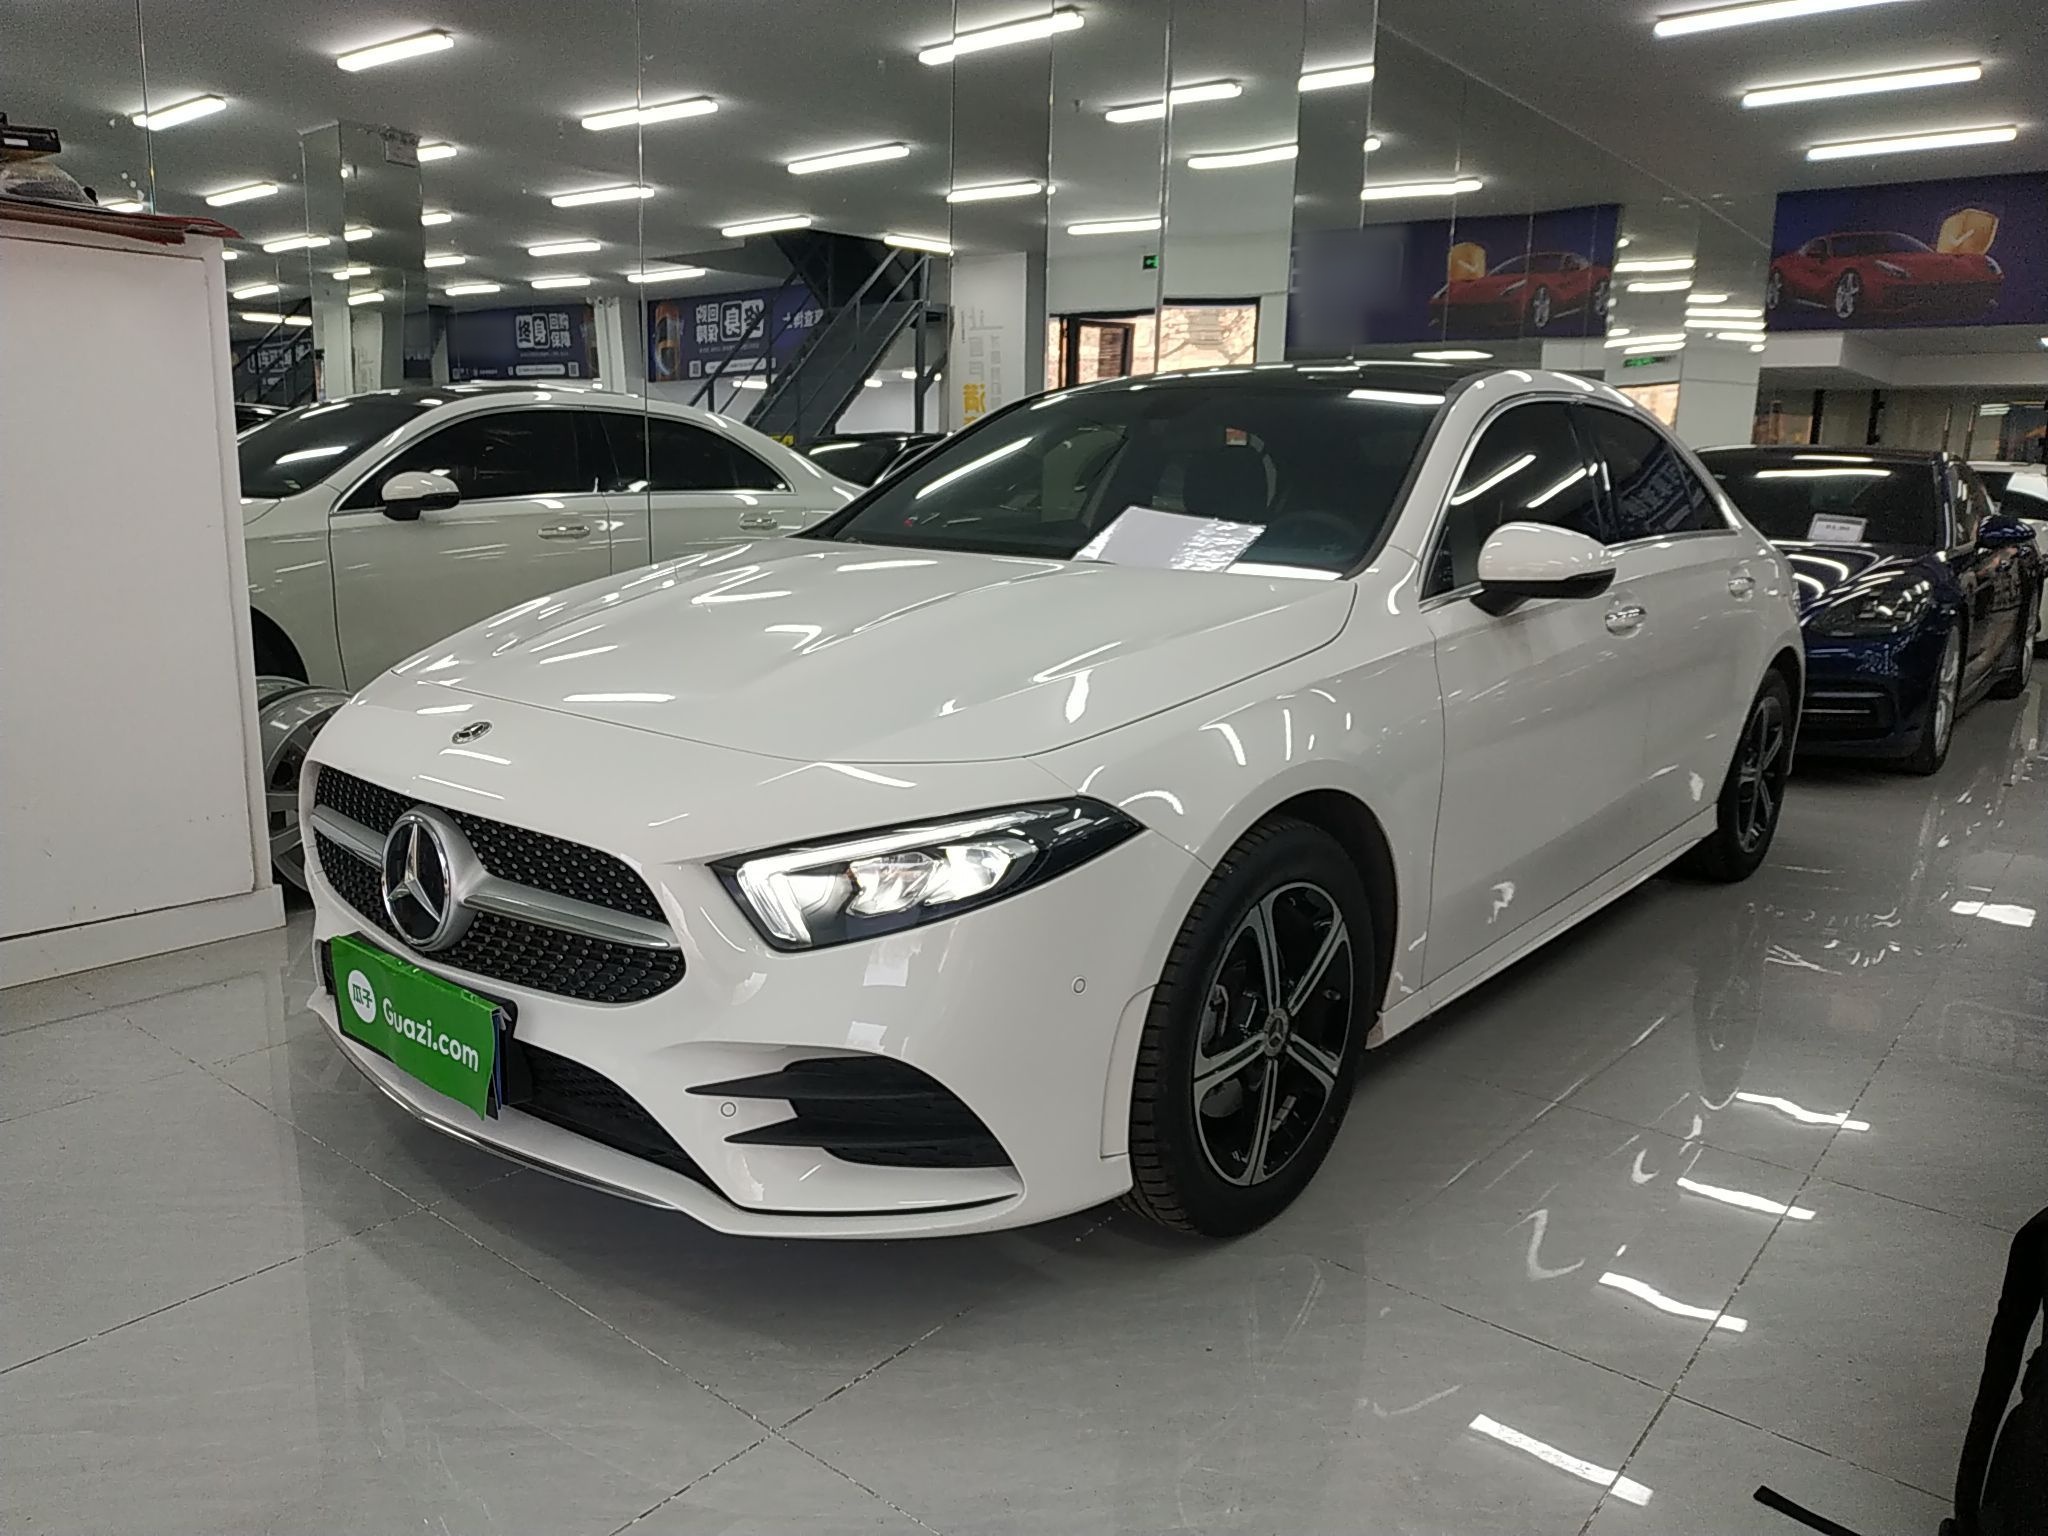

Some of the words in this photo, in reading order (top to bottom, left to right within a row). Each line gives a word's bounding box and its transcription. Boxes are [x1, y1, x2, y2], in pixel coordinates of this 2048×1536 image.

[517, 315, 549, 347] 终身
[352, 983, 373, 1008] 瓜子
[383, 998, 479, 1072] Guazi.com
